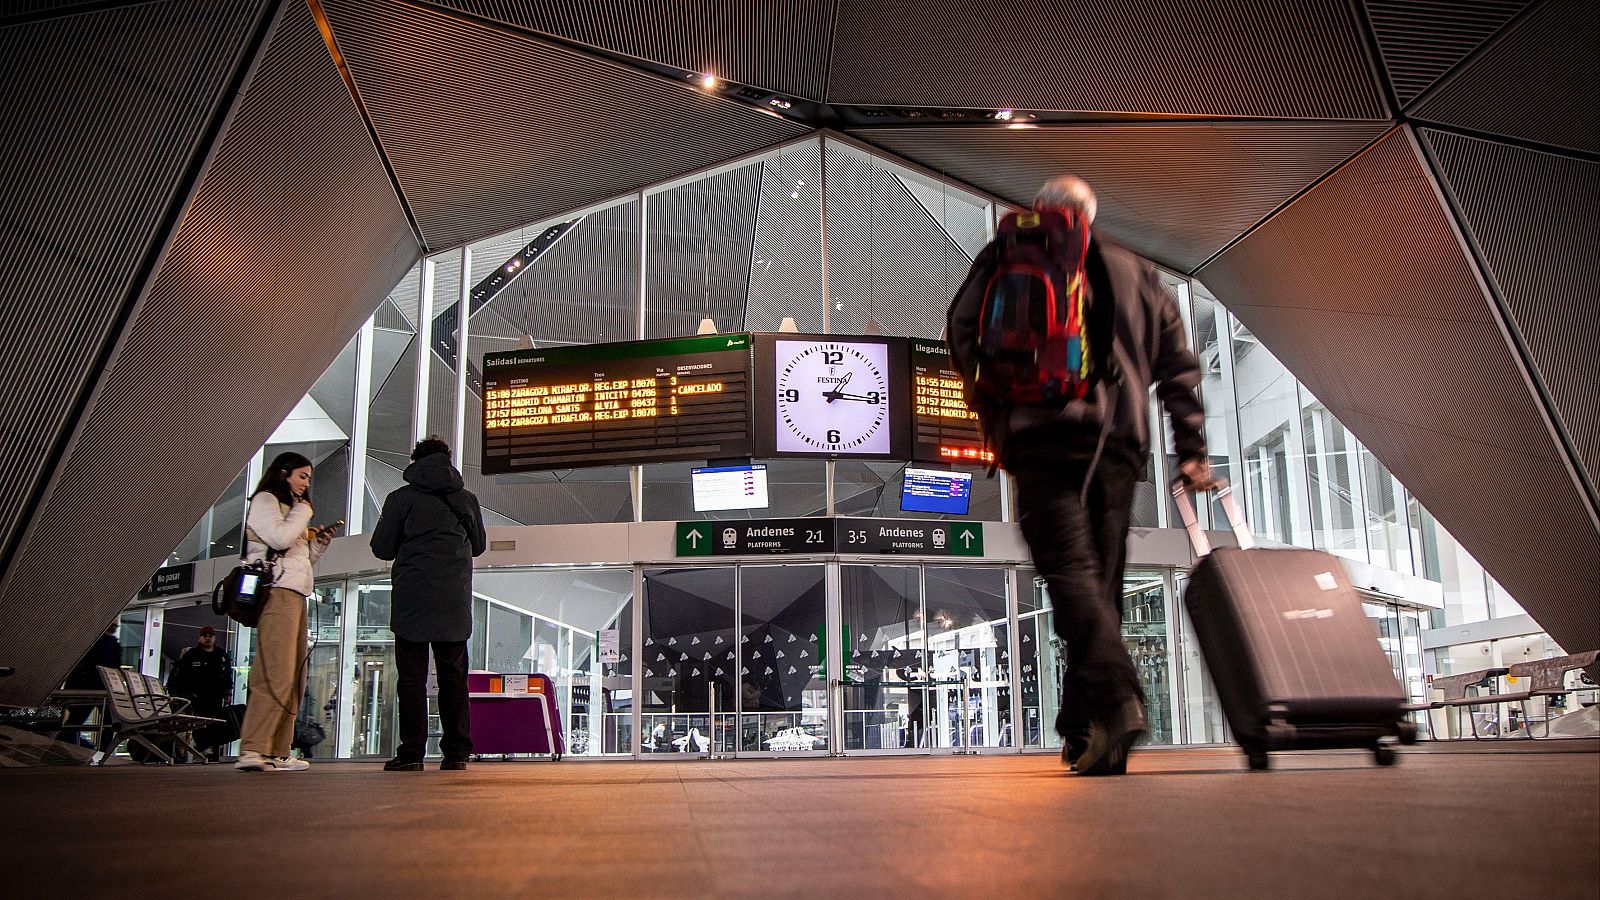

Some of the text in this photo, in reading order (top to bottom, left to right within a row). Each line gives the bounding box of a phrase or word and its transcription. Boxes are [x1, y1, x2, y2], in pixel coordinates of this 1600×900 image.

[916, 344, 947, 354] Llegadas
[486, 358, 513, 366] Salidas
[821, 352, 843, 365] 12
[511, 387, 548, 397] ZARAGOZA
[552, 383, 592, 394] MIRAFLOR.
[594, 381, 628, 391] REG.EXP
[671, 377, 677, 385] 3
[916, 376, 964, 390] 16:55 ZARAG
[486, 399, 510, 409] 16:12
[511, 397, 539, 407] MADRID
[594, 390, 628, 400] INTCITY
[678, 383, 722, 394] CANCELADO
[786, 389, 799, 403] 9
[867, 392, 880, 404] 3
[916, 387, 964, 399] 17:55 BILBA
[486, 409, 510, 418] 17:57
[511, 405, 552, 417] BARCELONA
[556, 403, 580, 413] SANTS
[594, 400, 619, 410] ALVIA
[671, 396, 676, 405] 1
[916, 396, 968, 410] 19:57 ZARAGO
[486, 419, 510, 428] 20:42
[511, 416, 548, 426] ZARAGOZA
[552, 412, 592, 424] MIRAFLOR.
[594, 409, 628, 420] REG.EXP
[671, 406, 677, 415] 5
[916, 406, 939, 416] 21:15
[940, 408, 967, 418] MADRID
[827, 430, 841, 443] 6
[746, 527, 794, 538] Andenes
[879, 527, 924, 538] Andenes
[158, 573, 180, 583] No pasar
